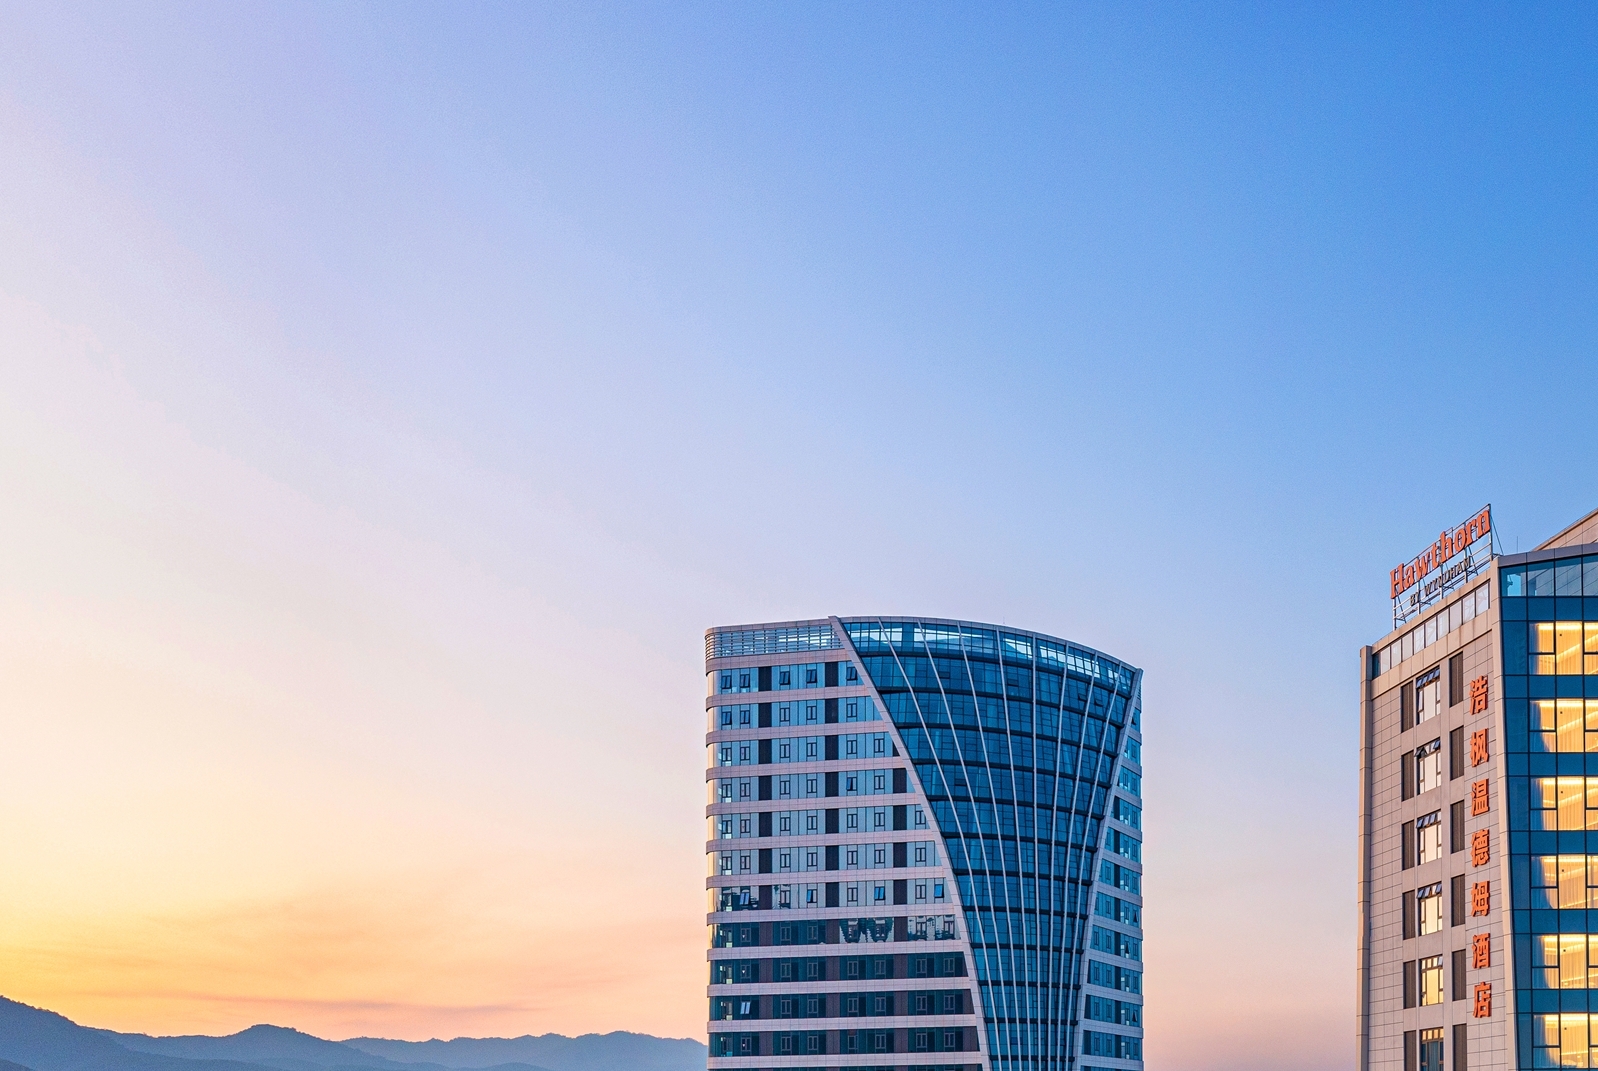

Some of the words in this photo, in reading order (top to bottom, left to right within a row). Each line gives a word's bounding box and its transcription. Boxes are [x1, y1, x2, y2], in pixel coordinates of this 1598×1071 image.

[1390, 509, 1491, 599] Hawthorn
[1410, 591, 1420, 607] BY
[1469, 675, 1492, 1018] 浩枫温德姆酒店
